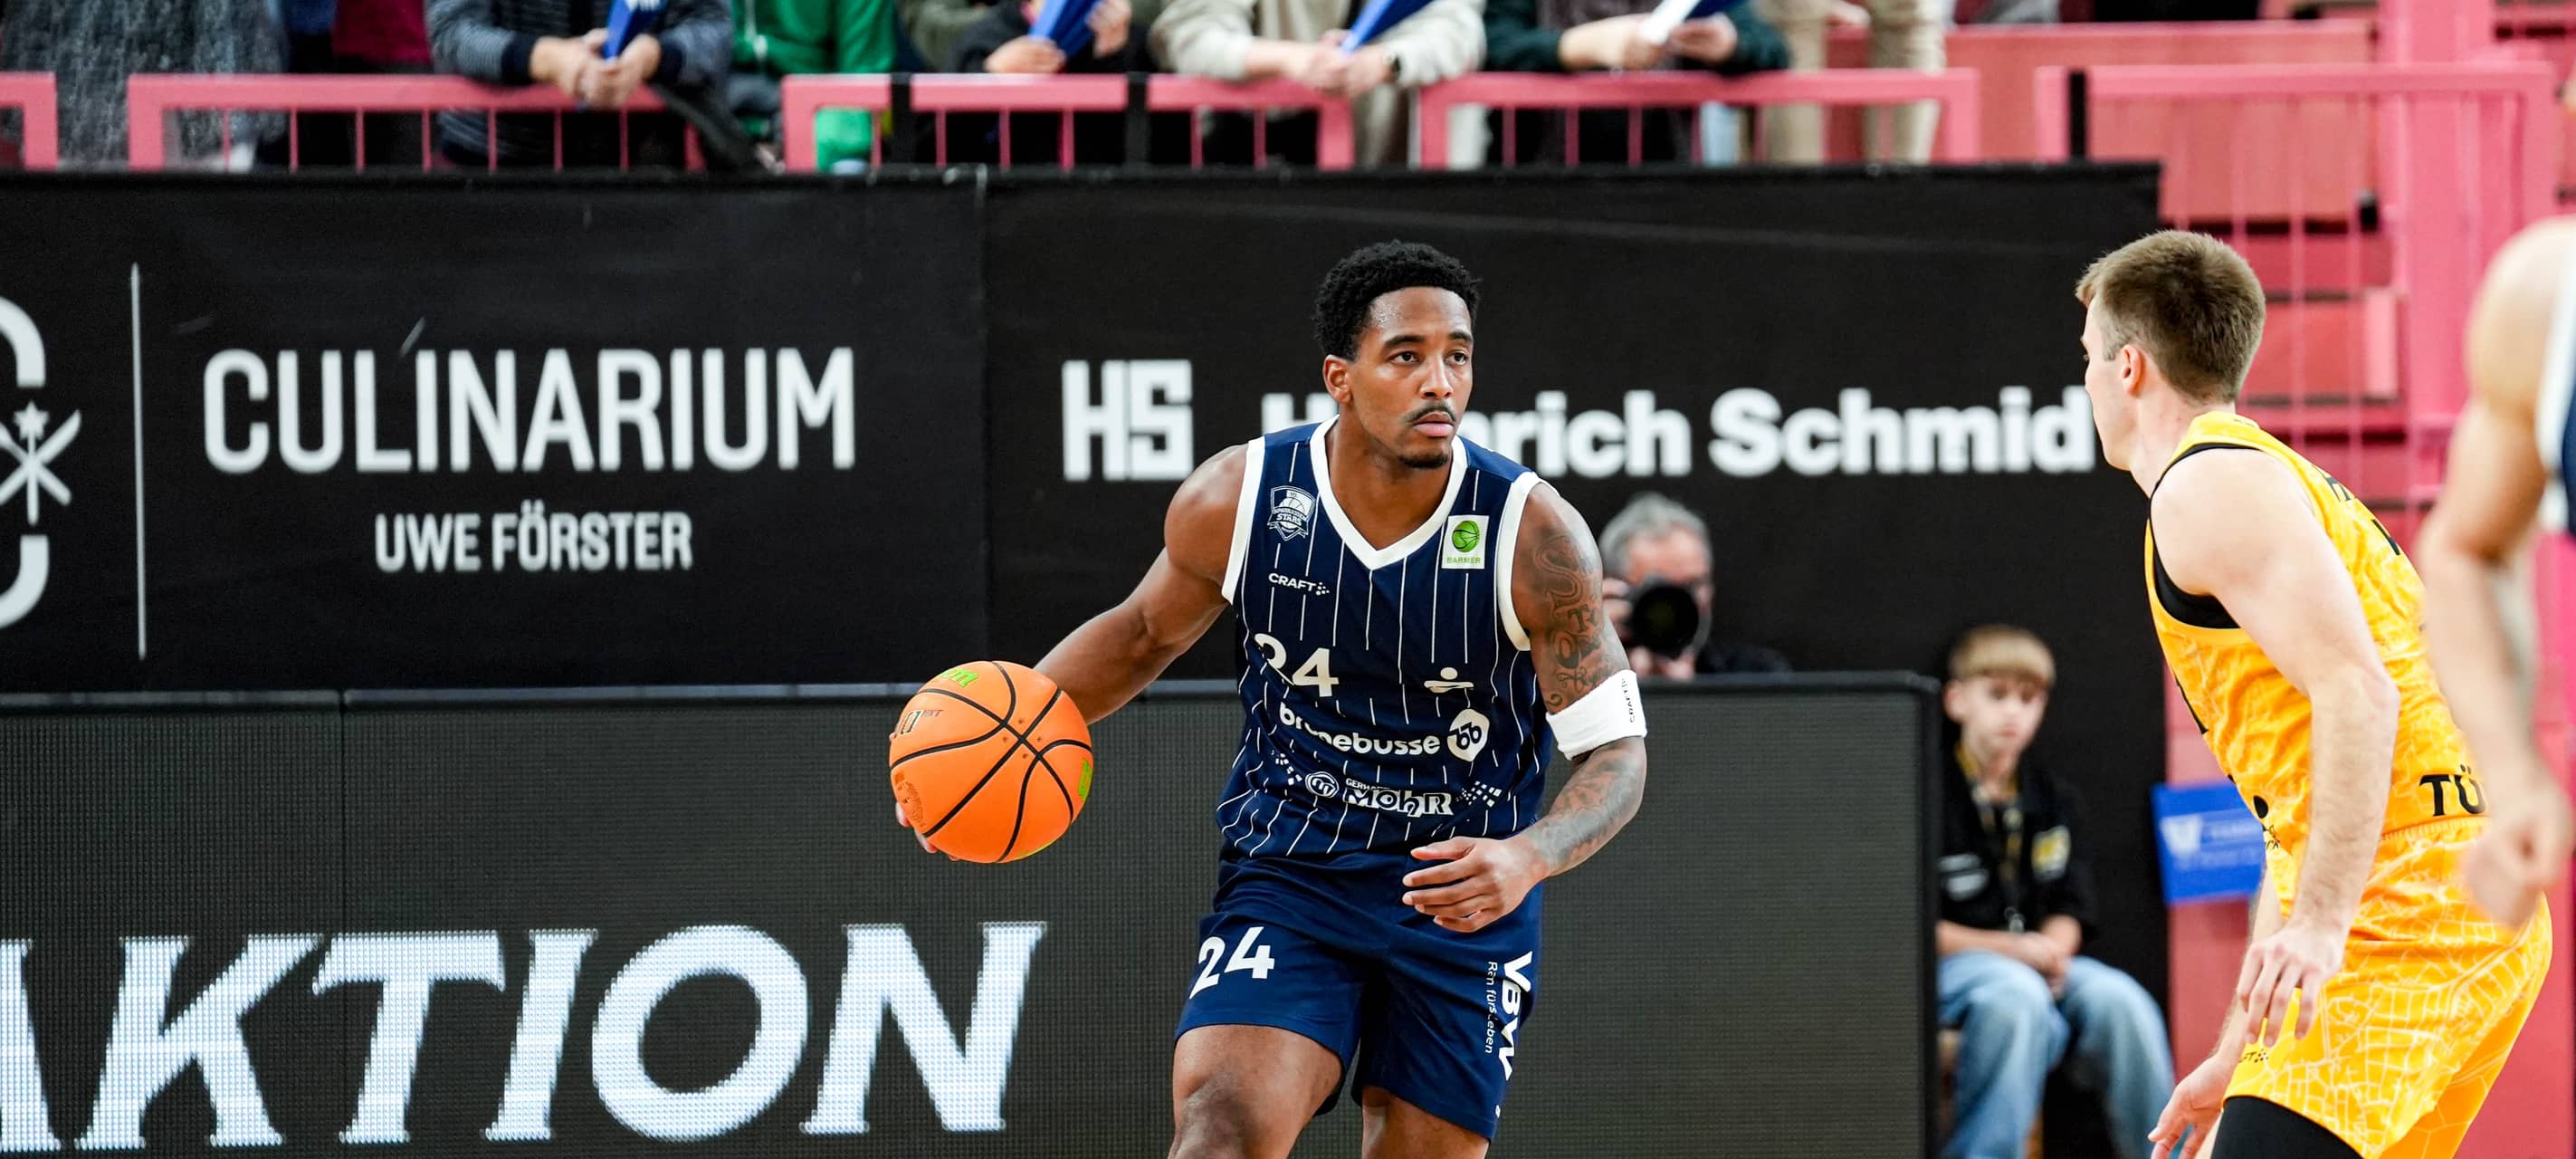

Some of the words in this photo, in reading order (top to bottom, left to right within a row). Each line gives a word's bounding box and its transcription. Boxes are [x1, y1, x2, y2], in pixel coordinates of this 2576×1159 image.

[204, 347, 855, 474] CULINARIUM
[1062, 359, 1193, 482] HS
[375, 513, 481, 571] UWE
[491, 499, 692, 571] FÖRSTER
[1268, 573, 1316, 592] CRAFT
[1189, 925, 1275, 1000] 24
